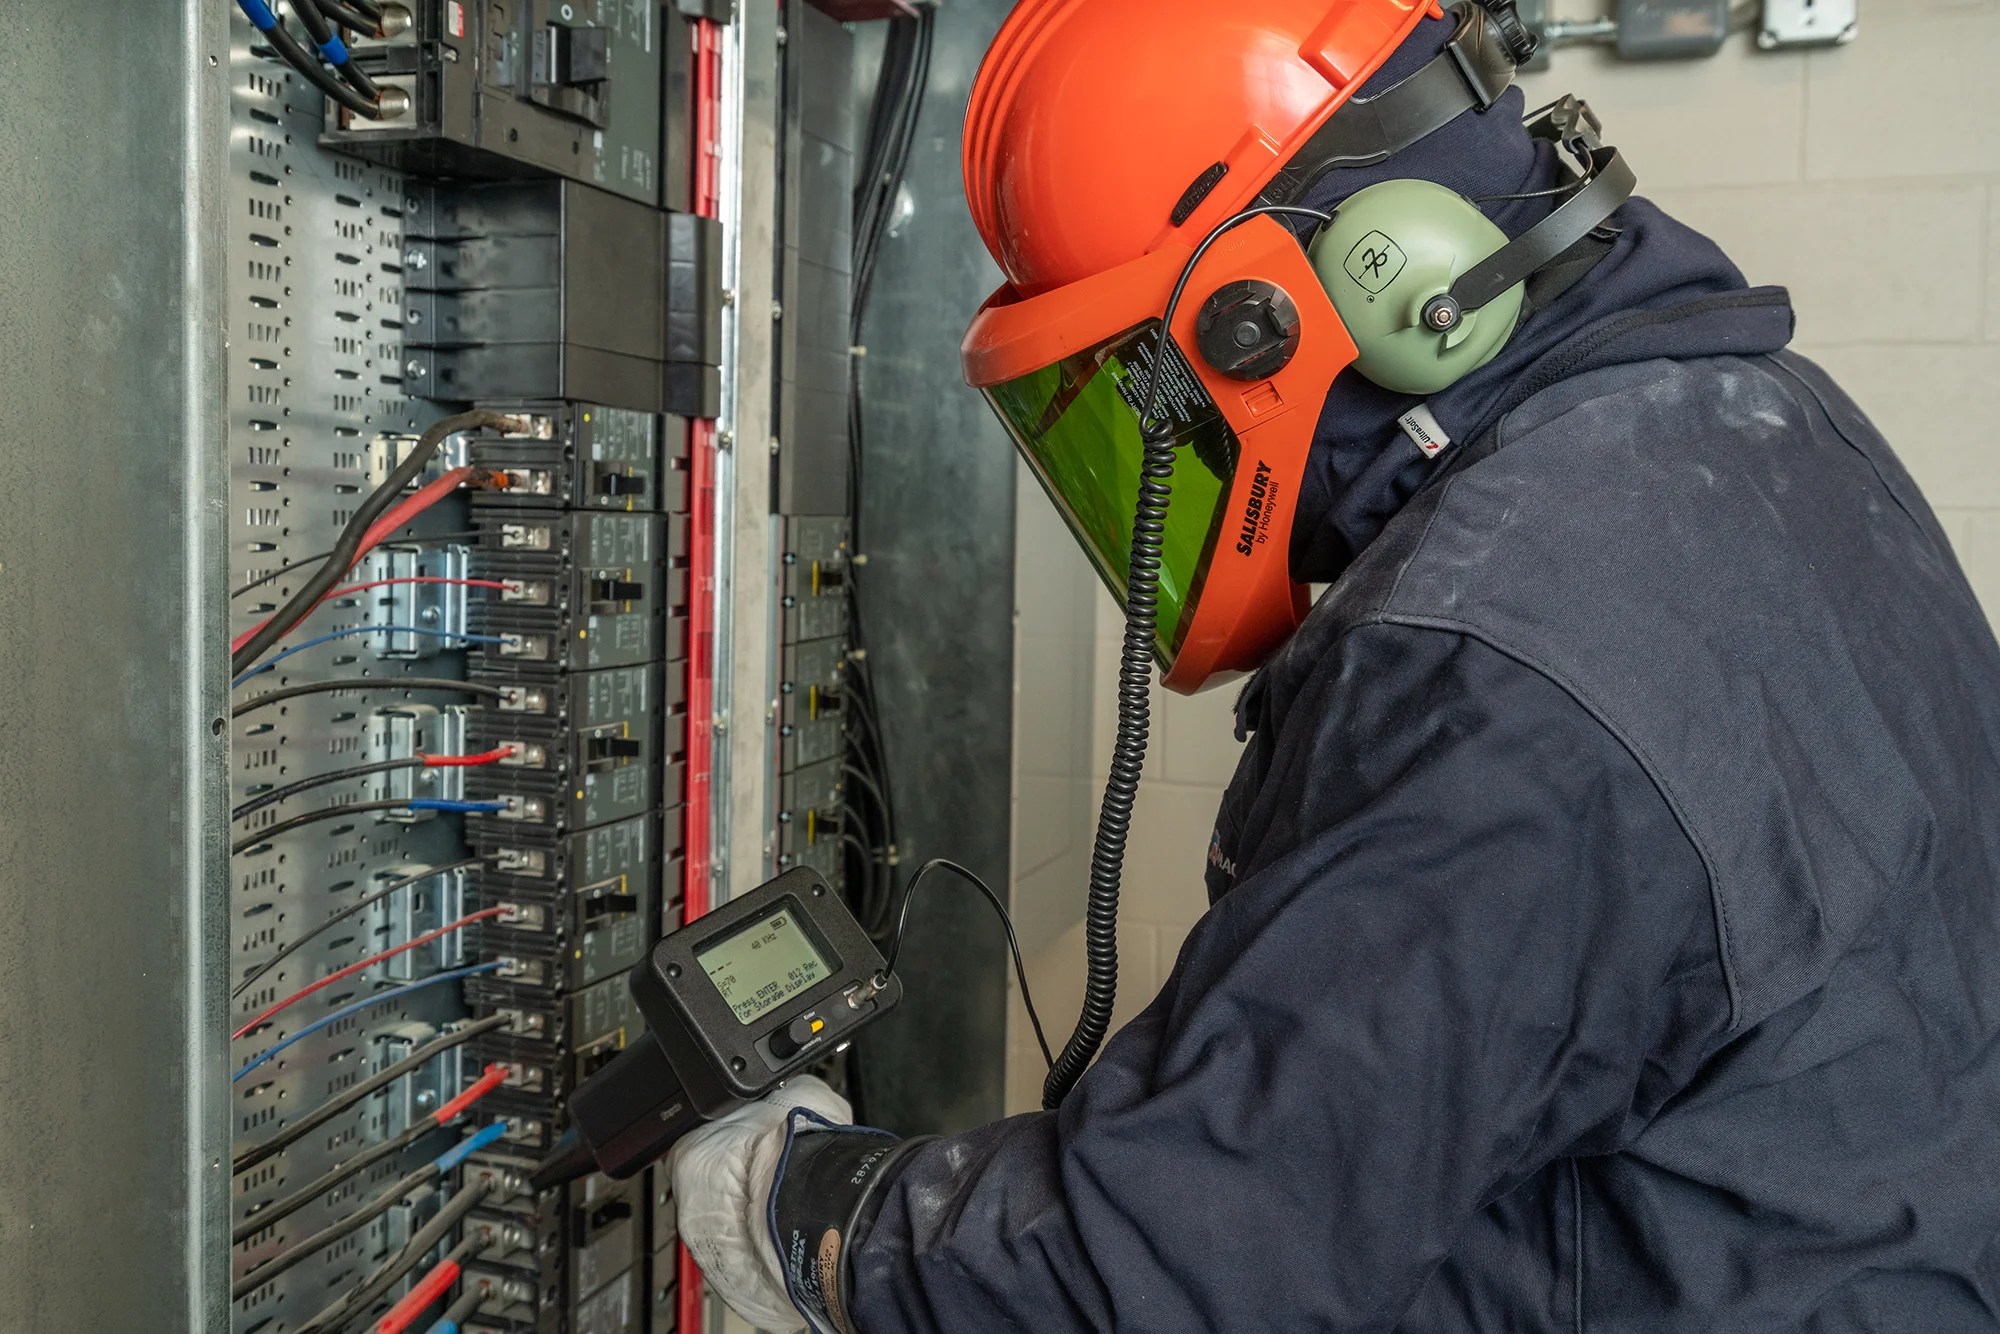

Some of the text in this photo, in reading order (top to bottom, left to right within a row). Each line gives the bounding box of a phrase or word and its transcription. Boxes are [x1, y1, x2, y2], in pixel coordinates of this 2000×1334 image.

[1236, 460, 1271, 557] SALISBURY
[1255, 481, 1279, 544] by Honeywell
[762, 932, 778, 945] KHz
[732, 998, 756, 1013] Press
[756, 982, 779, 999] ENTER
[802, 961, 818, 973] Rec
[739, 973, 816, 1020] for Storage Display
